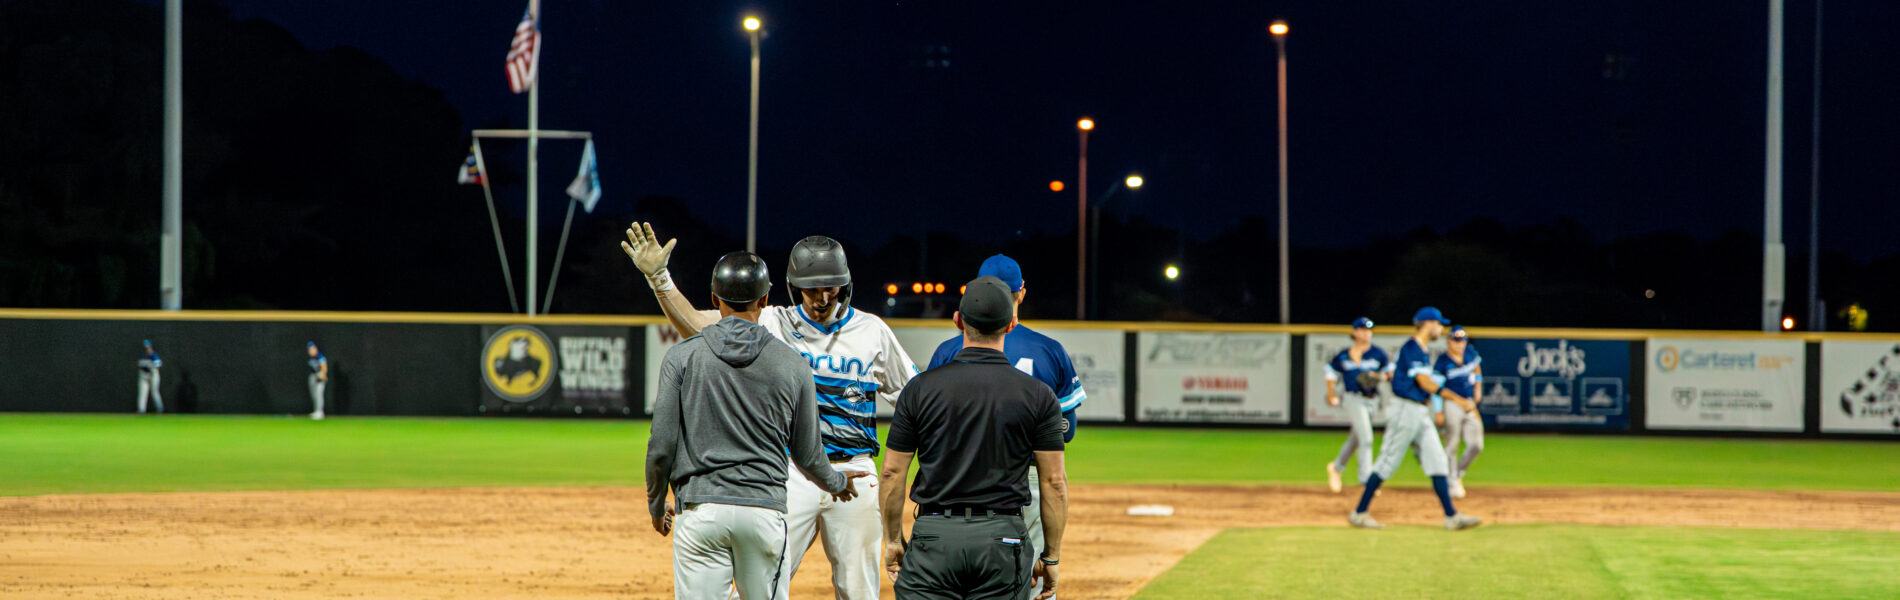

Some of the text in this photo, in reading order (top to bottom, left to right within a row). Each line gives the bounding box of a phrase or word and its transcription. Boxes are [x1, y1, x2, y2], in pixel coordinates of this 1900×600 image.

[560, 350, 625, 370] WILD
[1680, 349, 1756, 368] Carteret
[559, 370, 625, 391] WINGS
[1197, 376, 1249, 391] YAMAHA
